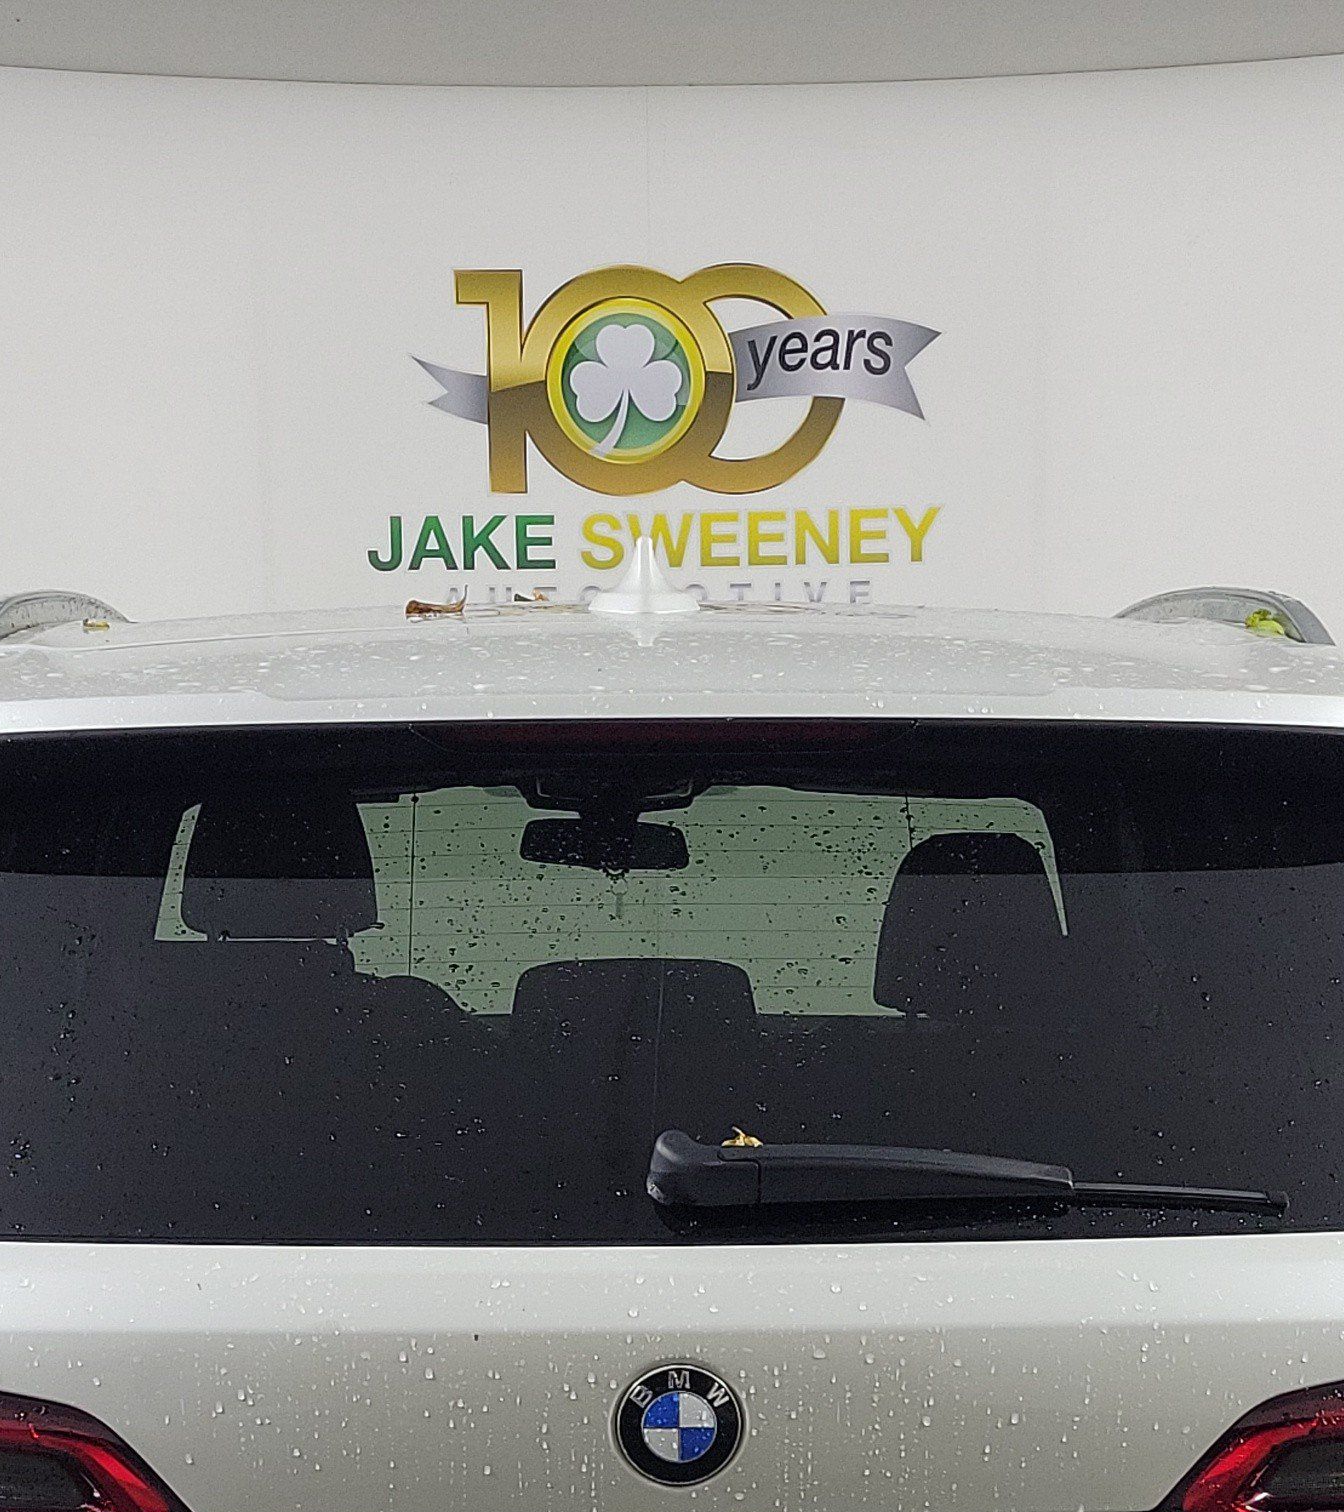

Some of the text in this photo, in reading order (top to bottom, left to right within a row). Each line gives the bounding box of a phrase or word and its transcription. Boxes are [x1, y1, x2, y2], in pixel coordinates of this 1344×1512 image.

[454, 262, 895, 496] 100 years
[367, 506, 943, 572] JAKE SWEENEY
[630, 1369, 730, 1409] BMW
